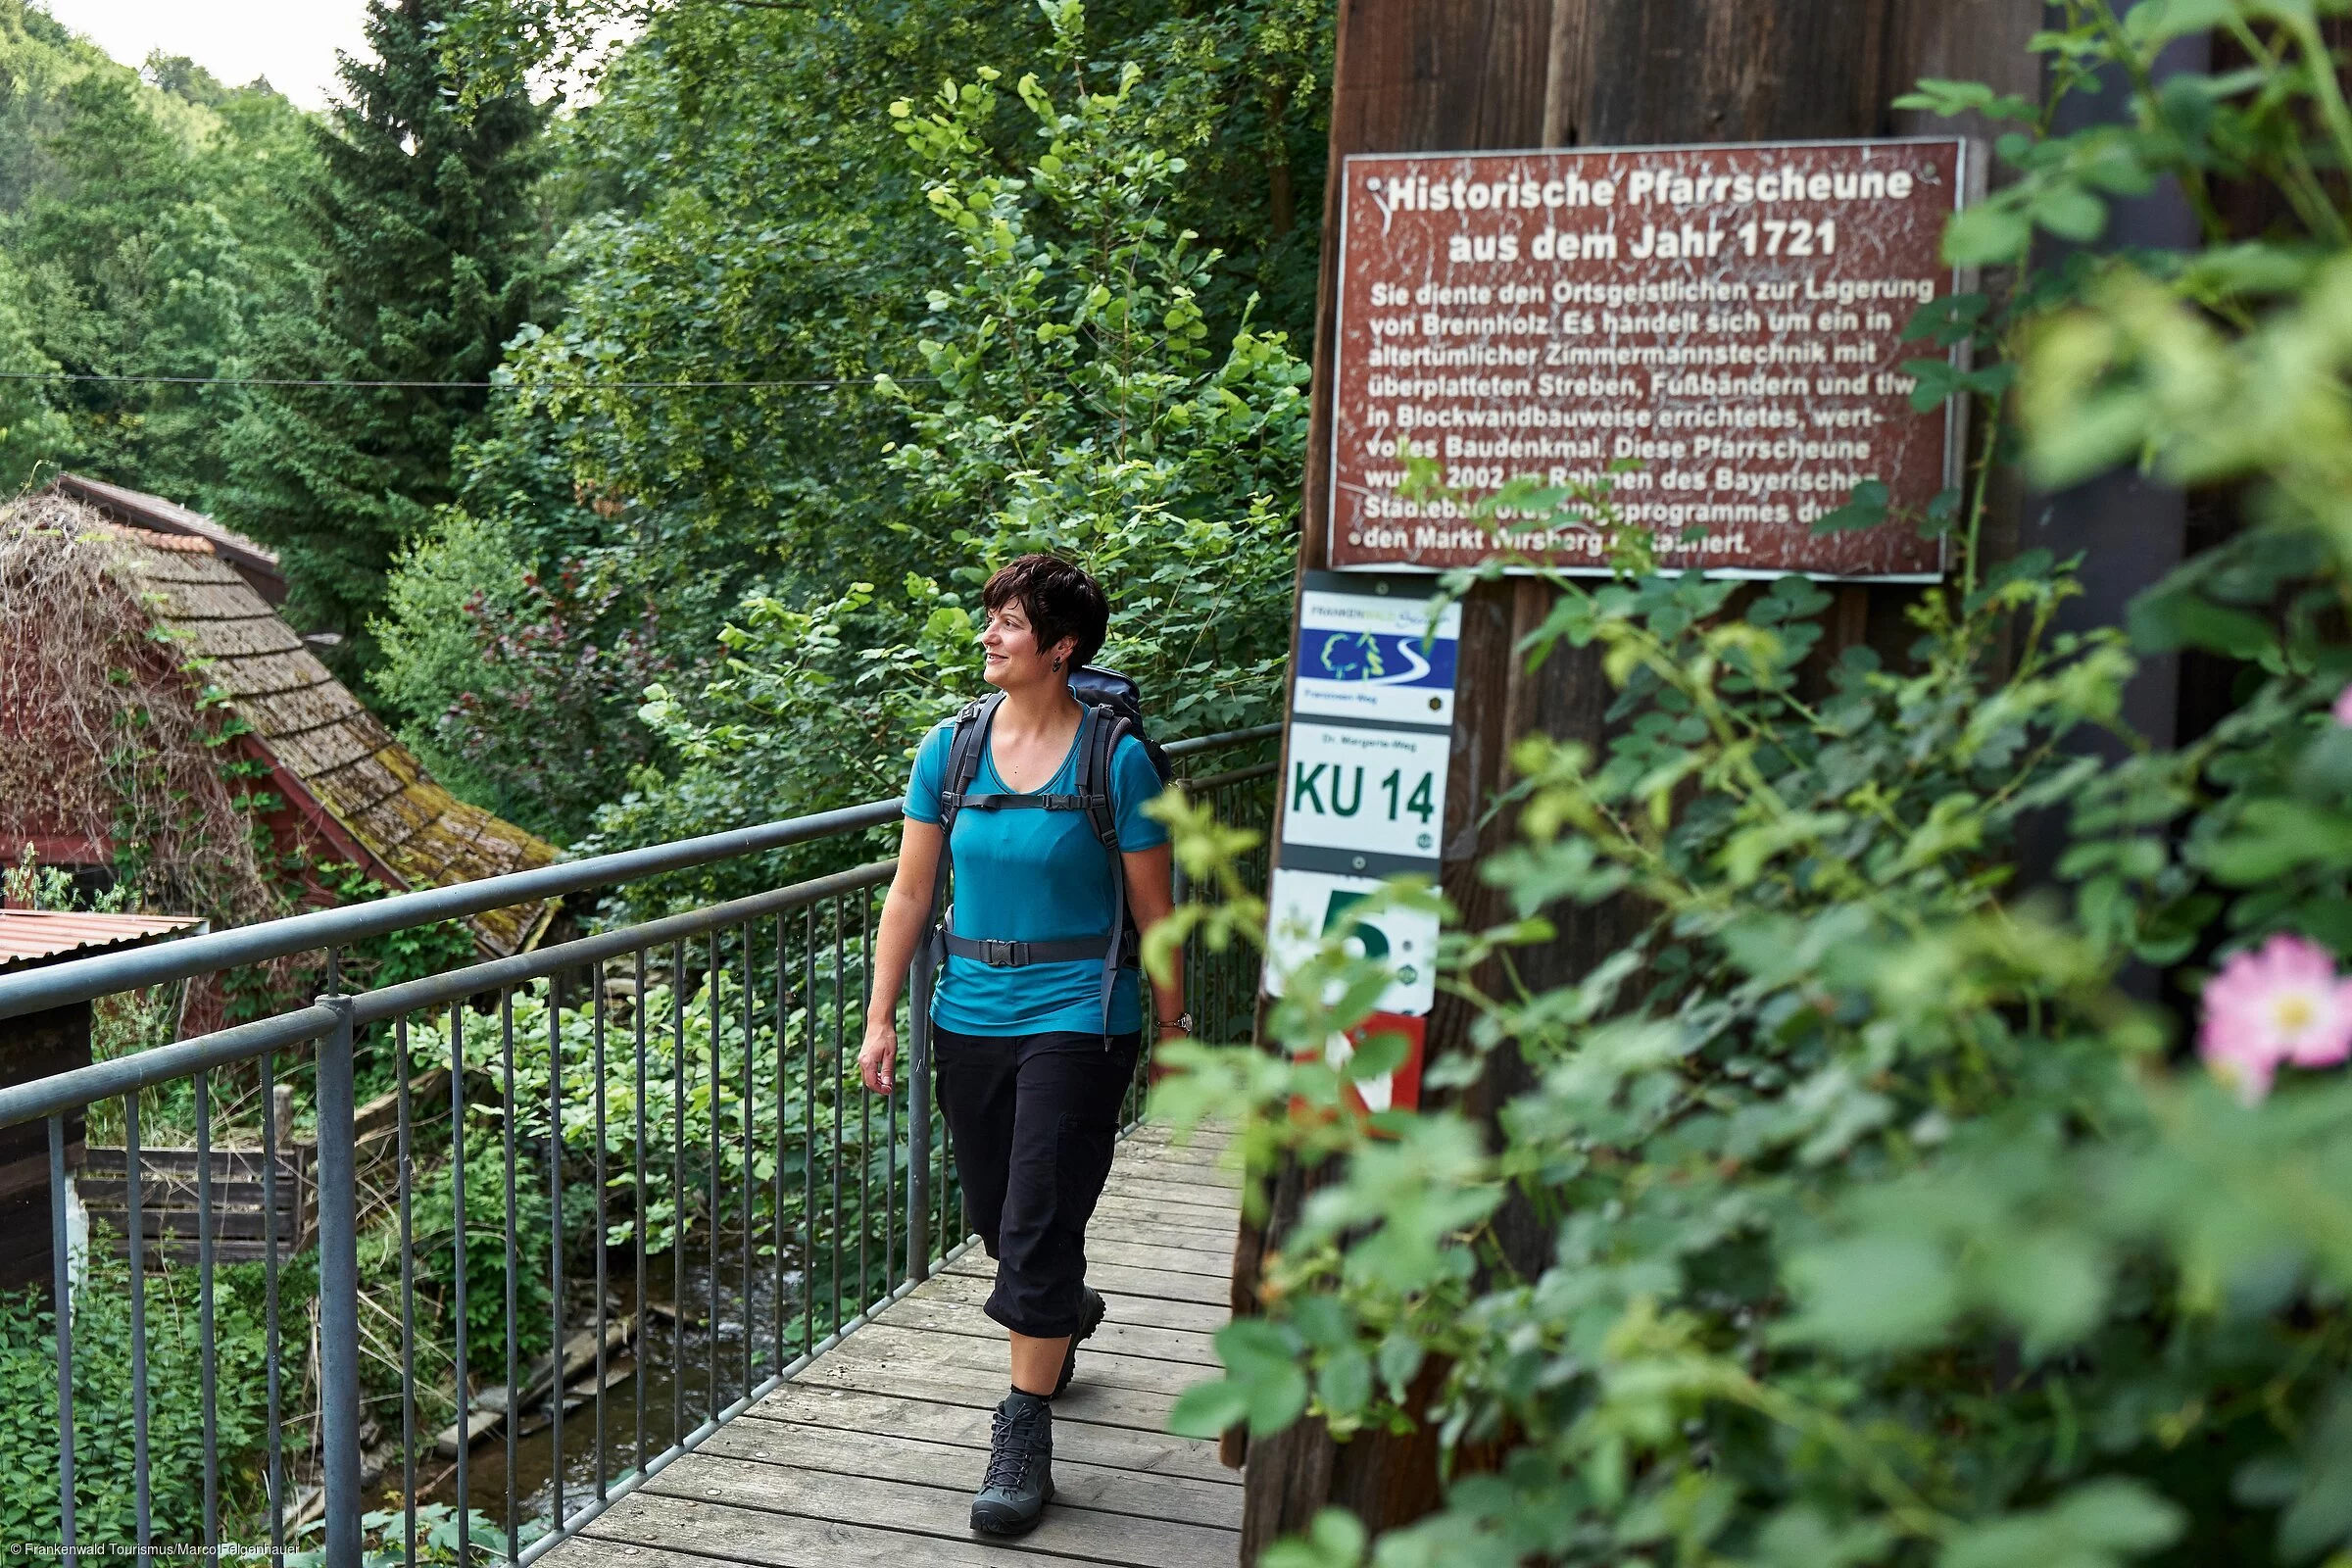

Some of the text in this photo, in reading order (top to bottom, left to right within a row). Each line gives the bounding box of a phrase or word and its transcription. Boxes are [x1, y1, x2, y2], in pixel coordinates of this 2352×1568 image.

[1388, 168, 1914, 212] Historische Pfarrscheune
[1448, 218, 1837, 264] aus dem Jahr 1721
[1371, 277, 1936, 308] Sie diente den Ortsgeistlichen zur Lagerung
[1368, 317, 1416, 336] von
[1562, 311, 1596, 335] Es
[1601, 309, 1699, 334] handelt
[1705, 310, 1762, 333] sich
[1767, 312, 1812, 332] um
[1817, 310, 1860, 332] ein
[1865, 310, 1893, 331] in
[1367, 341, 1878, 368] altertümlicher Zimmermannstechnik mit
[1367, 374, 1532, 402] überplatteten
[1538, 373, 1644, 400] Streben,
[1650, 372, 1811, 397] Fußbändern
[1816, 373, 1870, 396] und
[1365, 403, 1884, 432] in Blockwandbauweise errichtetes, wert-
[1444, 434, 1607, 460] Baudenkmal.
[1613, 434, 1688, 460] Diese
[1692, 434, 1871, 461] Pfarrscheune
[1446, 466, 1505, 489] 2002
[1659, 468, 1708, 492] des
[1714, 466, 1881, 497] Bayerische
[1362, 525, 1409, 549] den
[1414, 525, 1486, 550] Markt
[1293, 760, 1435, 824] KU 14
